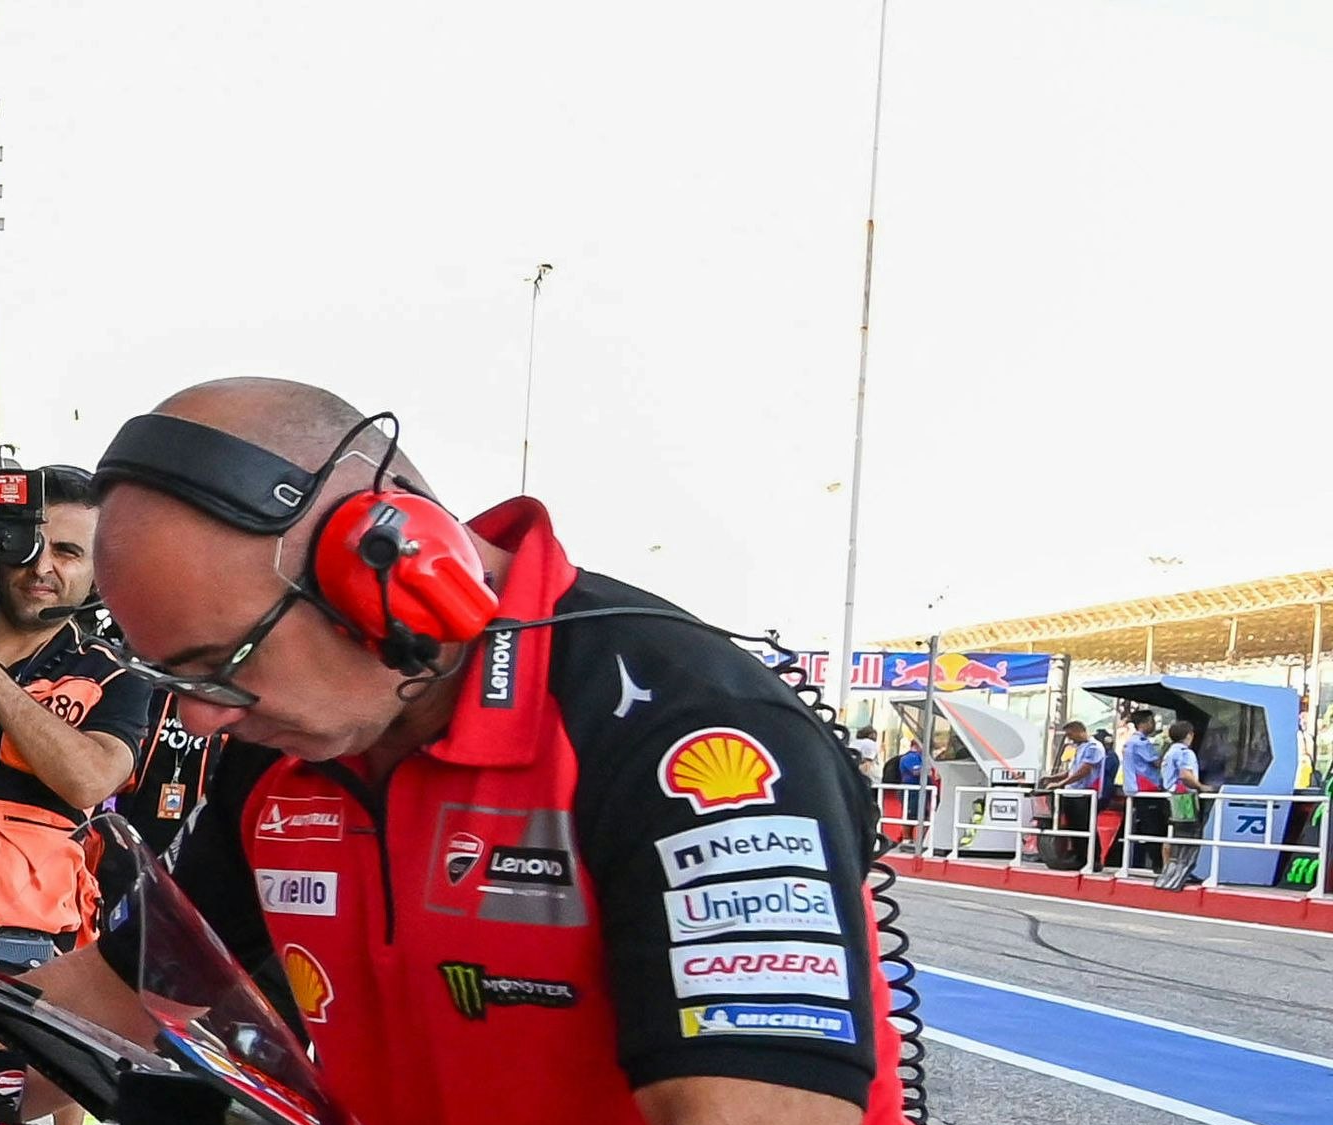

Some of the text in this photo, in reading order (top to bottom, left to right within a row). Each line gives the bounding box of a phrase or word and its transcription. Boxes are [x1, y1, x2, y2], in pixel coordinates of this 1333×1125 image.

[710, 829, 813, 859] NetApp
[683, 953, 839, 977] CARRERA
[737, 1011, 843, 1034] MICHELIN
